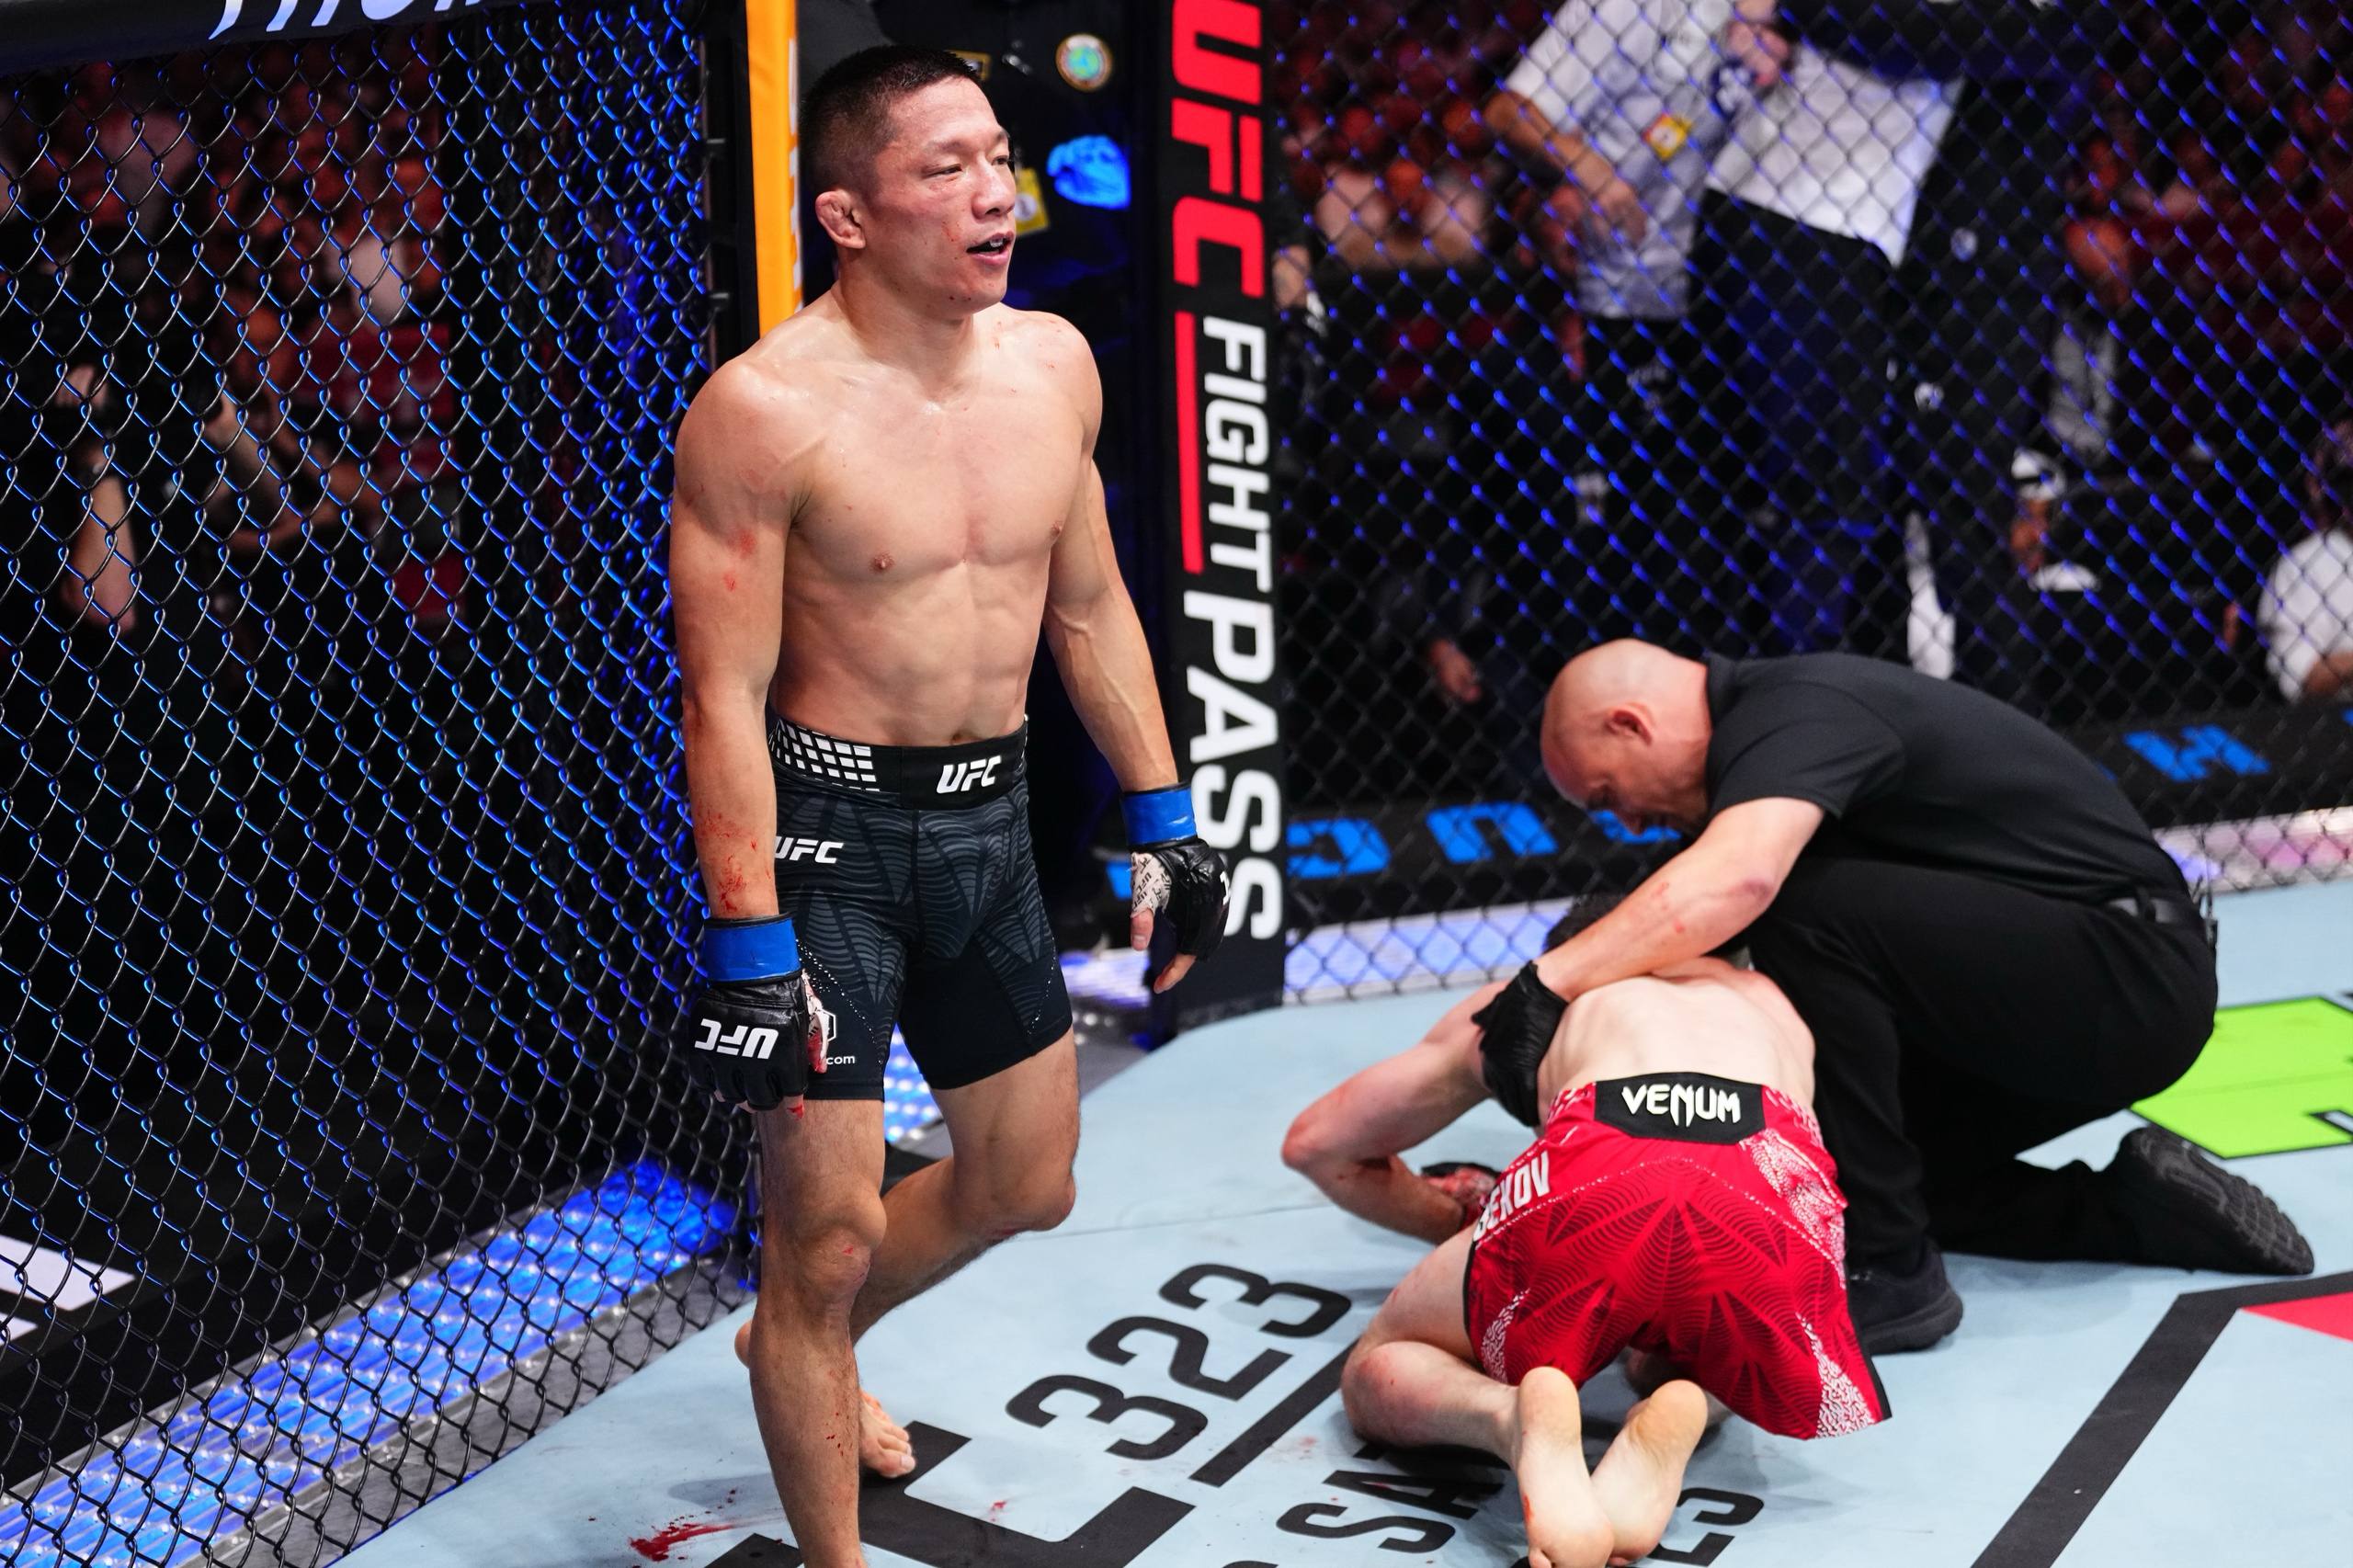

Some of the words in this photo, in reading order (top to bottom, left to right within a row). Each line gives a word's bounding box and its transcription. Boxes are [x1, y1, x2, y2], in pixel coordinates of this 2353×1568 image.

[1171, 0, 1264, 299] UFC
[1202, 315, 1272, 594] FIGHT
[936, 755, 1002, 794] UFC
[1184, 590, 1283, 940] PASS
[774, 835, 845, 864] UFC
[694, 1017, 779, 1060] UFC
[1621, 1083, 1741, 1128] VENUM
[1005, 1262, 1352, 1461] 323
